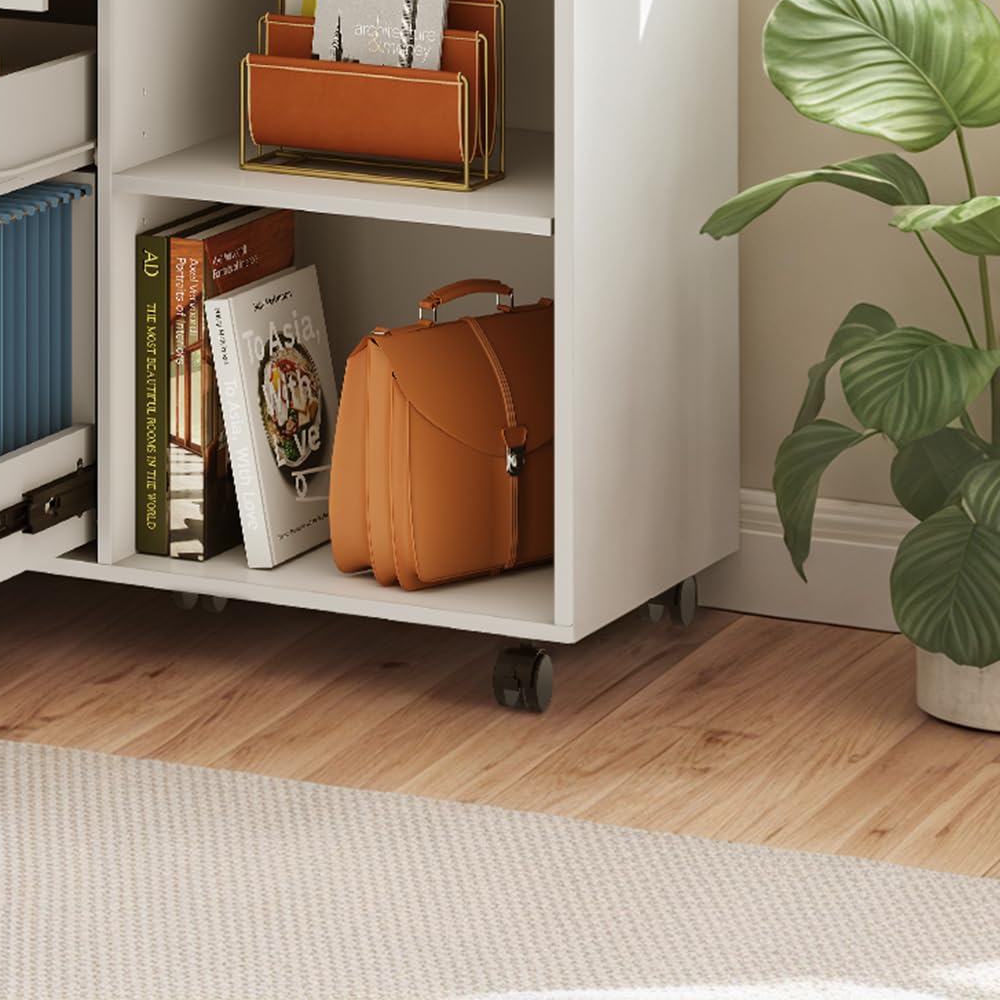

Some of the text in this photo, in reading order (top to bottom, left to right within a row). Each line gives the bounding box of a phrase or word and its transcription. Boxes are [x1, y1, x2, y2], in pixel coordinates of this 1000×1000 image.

[143, 249, 160, 278] AD
[175, 257, 187, 302] Portraits
[175, 304, 187, 317] of
[145, 326, 157, 355] MOST
[241, 329, 265, 366] To
[268, 309, 321, 357] Asia,
[145, 357, 157, 414] BEAUTIFUL
[145, 416, 157, 454] ROOMS
[236, 447, 252, 486] With
[145, 493, 157, 531] WORLD
[243, 491, 258, 531] Love
